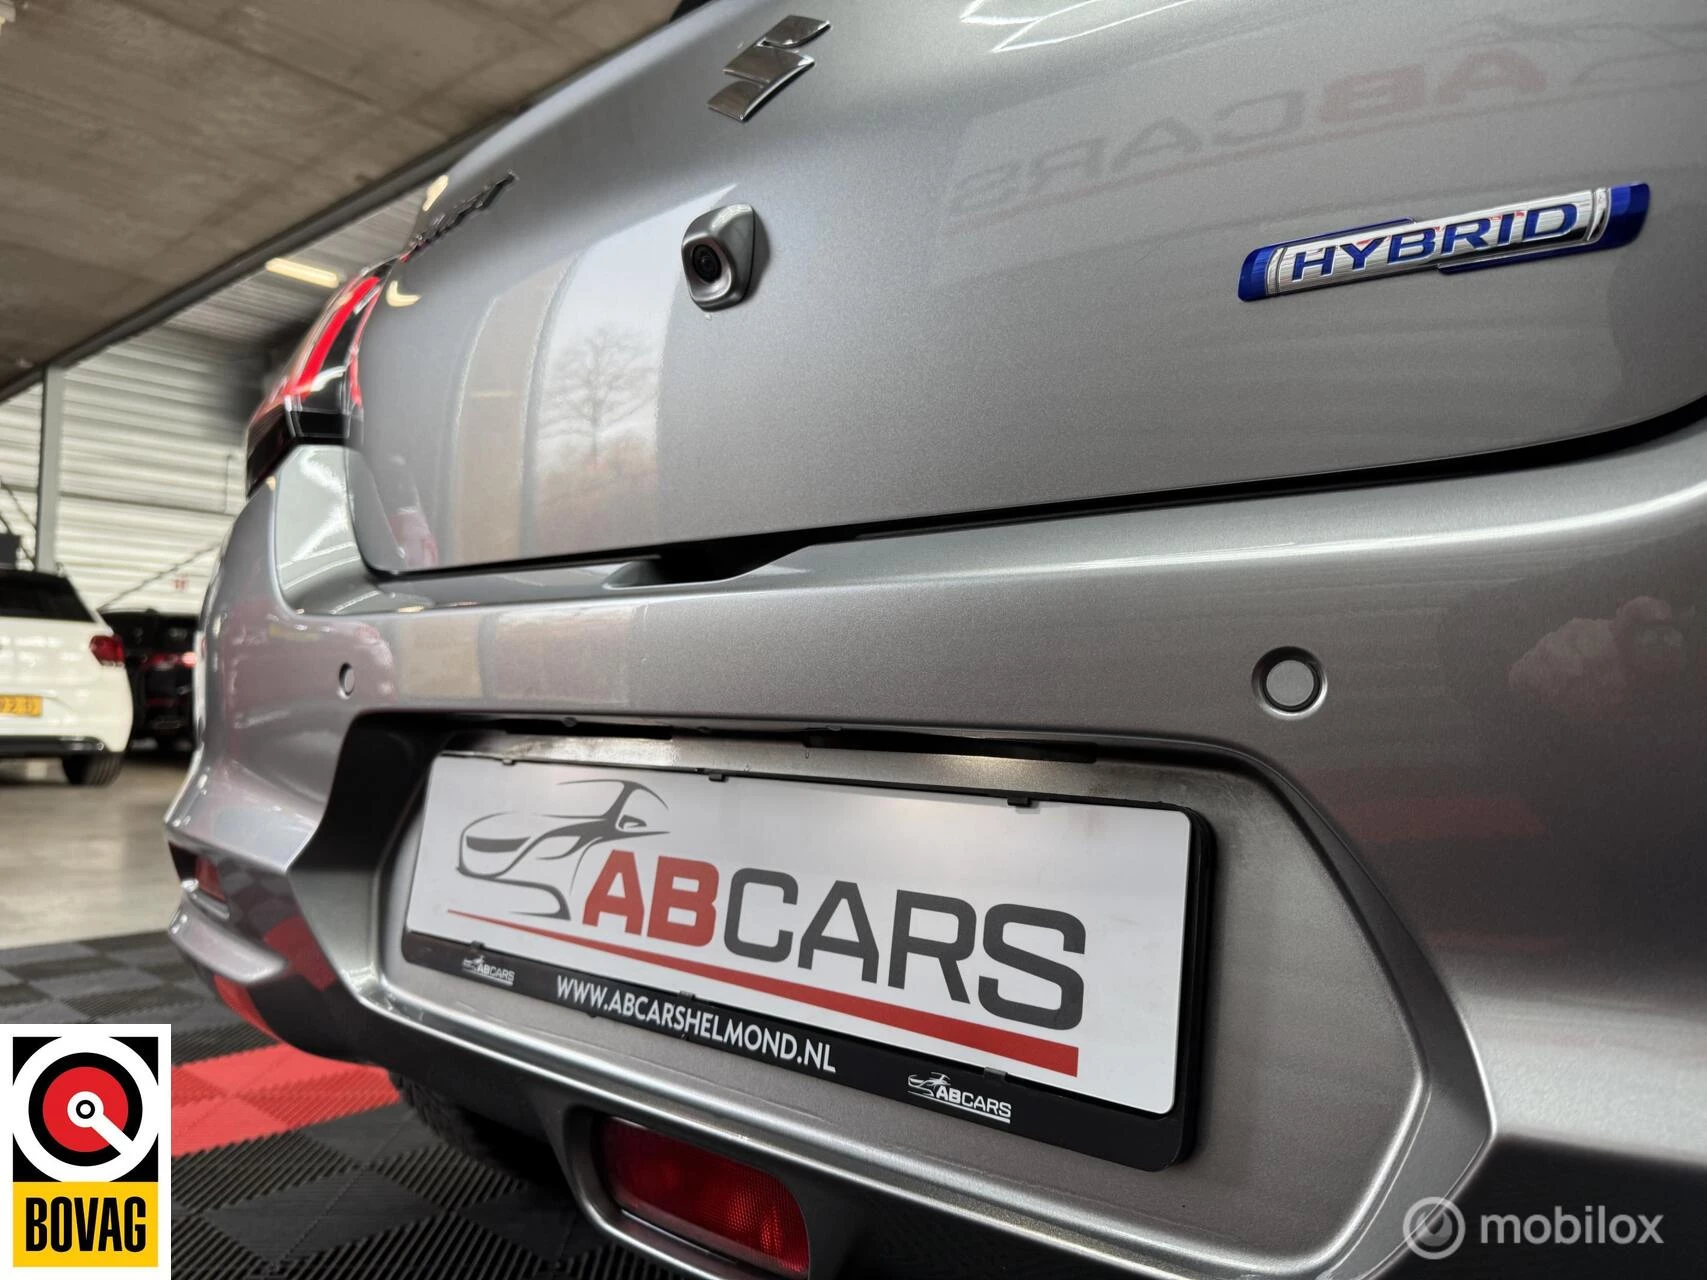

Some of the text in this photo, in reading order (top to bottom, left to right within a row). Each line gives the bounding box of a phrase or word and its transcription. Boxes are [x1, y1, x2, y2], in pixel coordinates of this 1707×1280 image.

[1290, 203, 1579, 282] HYBRID
[477, 963, 515, 982] ABCARS
[581, 848, 1087, 1031] ABCARS
[556, 975, 837, 1074] WWW.ABCARSHELMOND.NL
[935, 1085, 1012, 1118] ABCARS
